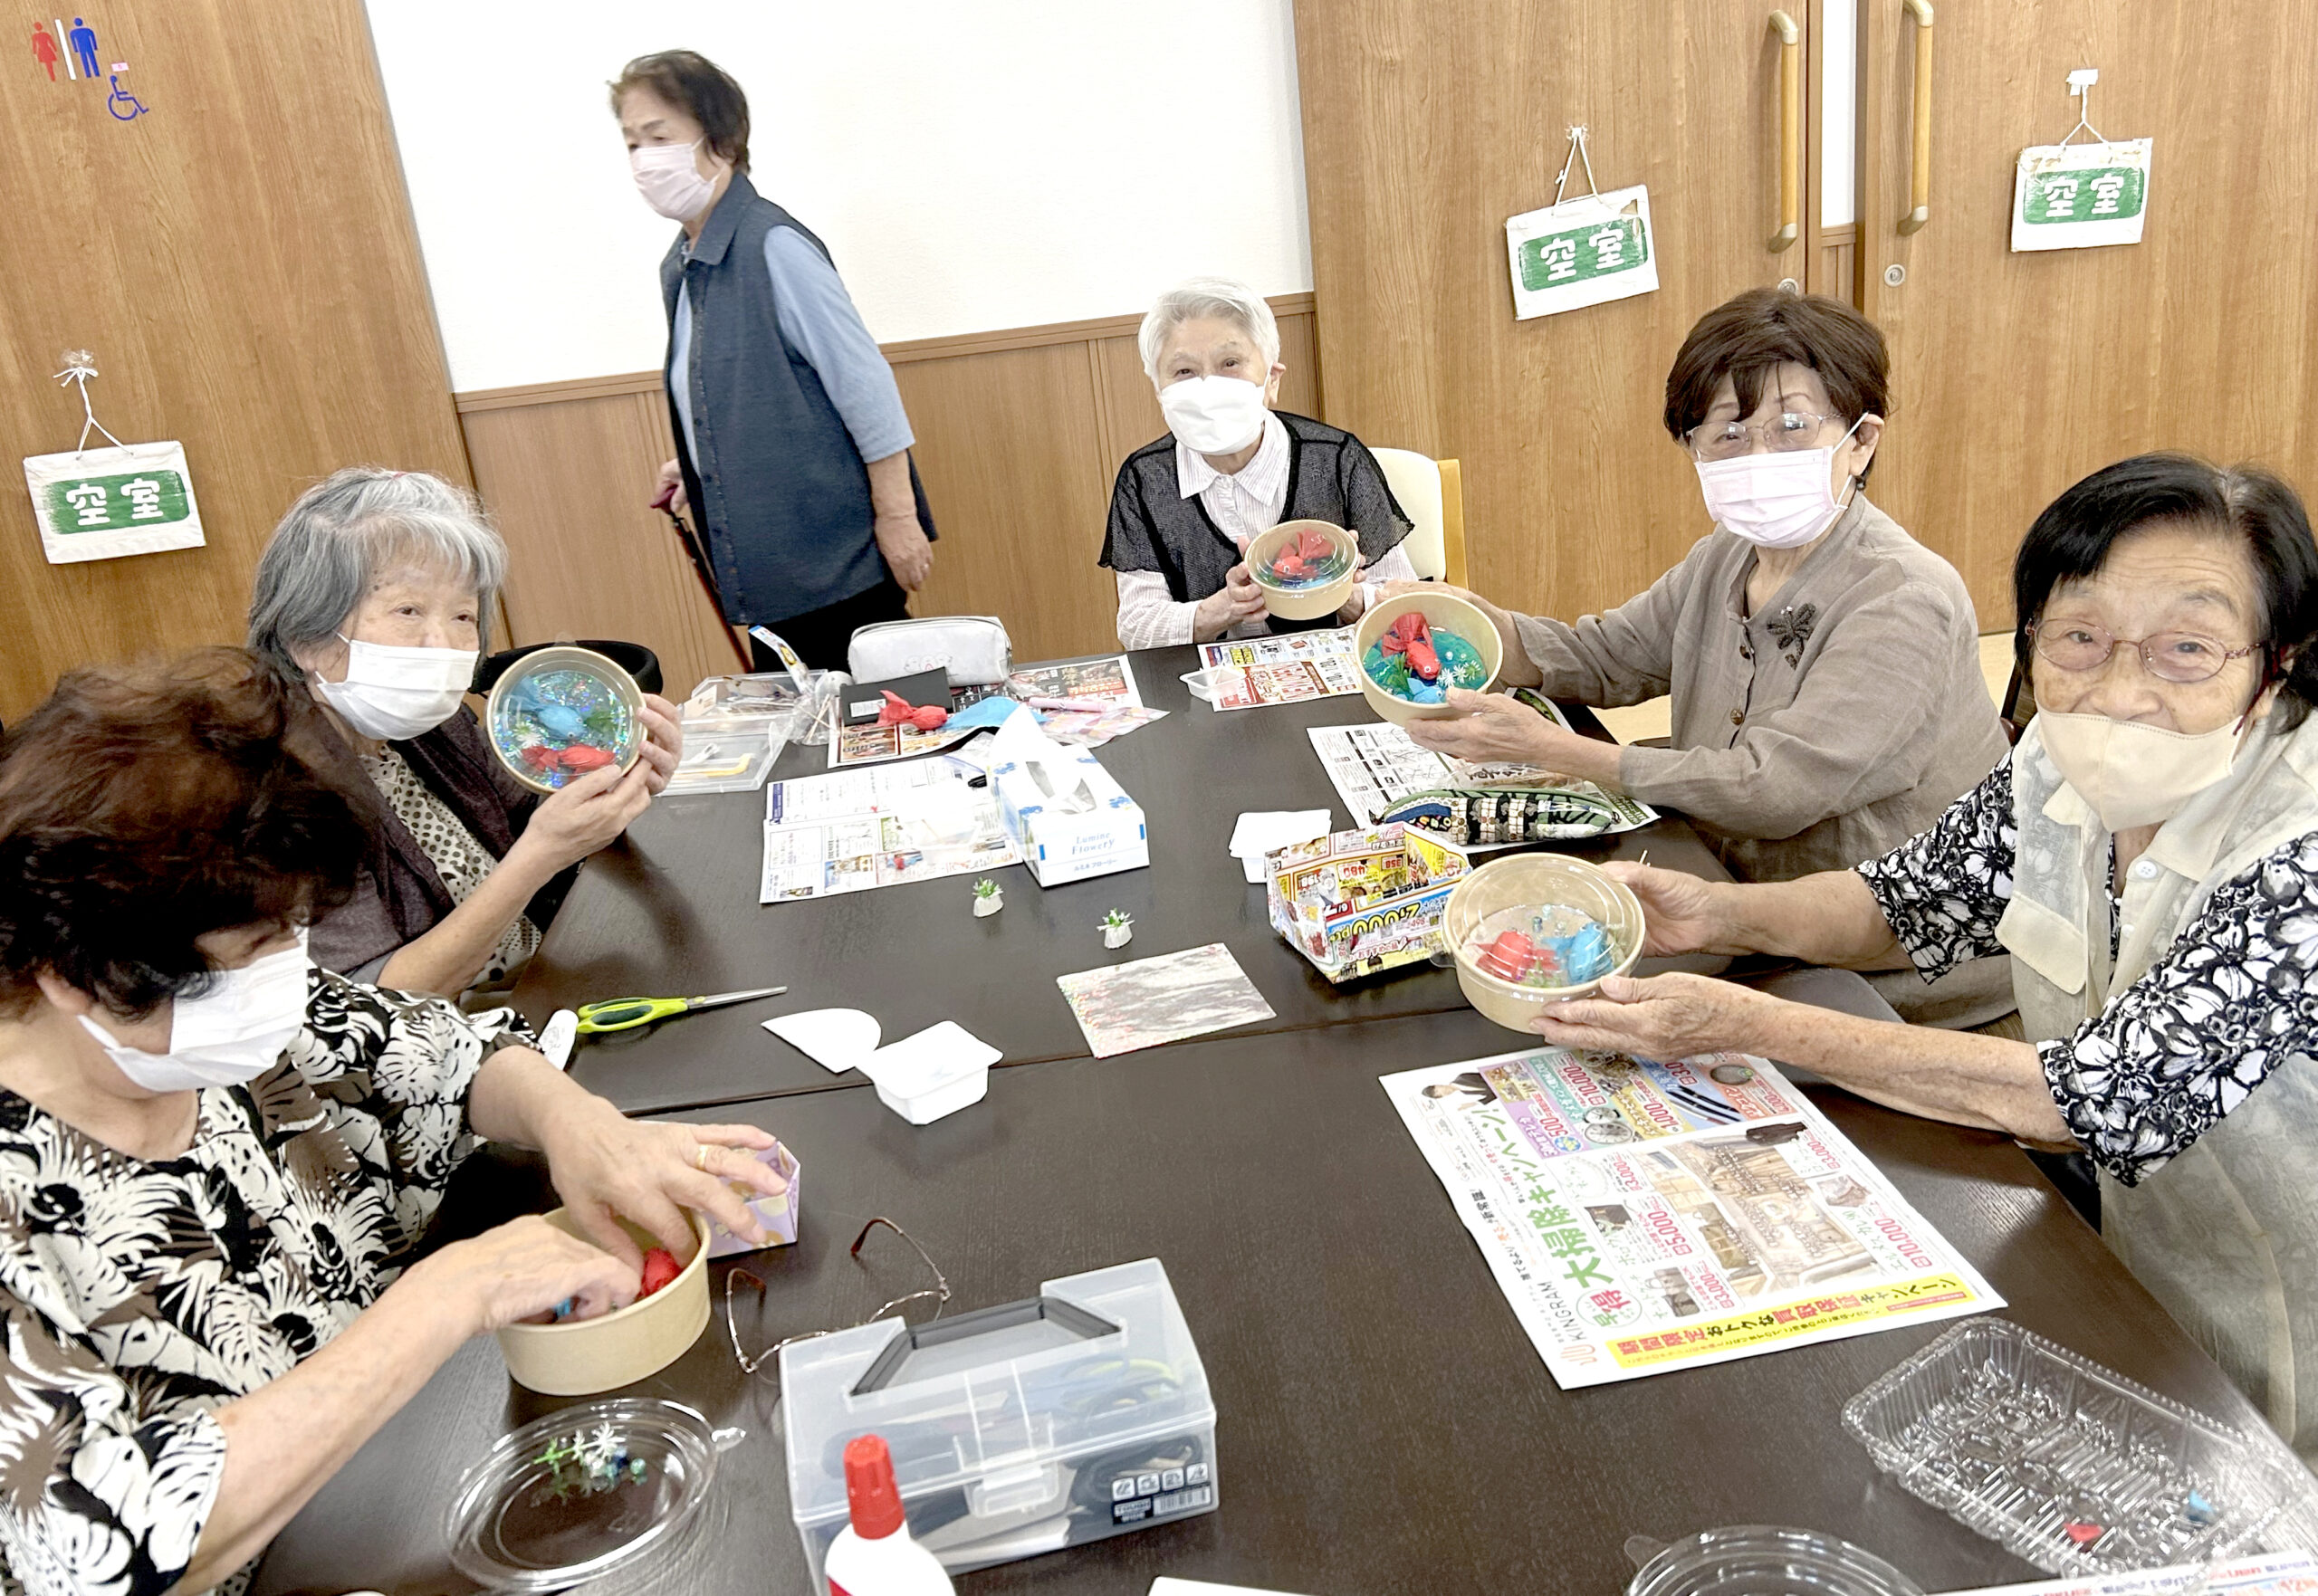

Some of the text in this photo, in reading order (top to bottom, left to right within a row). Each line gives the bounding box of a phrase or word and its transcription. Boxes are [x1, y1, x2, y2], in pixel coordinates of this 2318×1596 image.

[2044, 173, 2124, 217] 空室
[1540, 227, 1624, 281] 空室
[65, 477, 164, 526] 空室
[1072, 838, 1115, 855] Flowery
[1077, 833, 1110, 844] Lumine
[1535, 1280, 1588, 1342] KINGRAM
